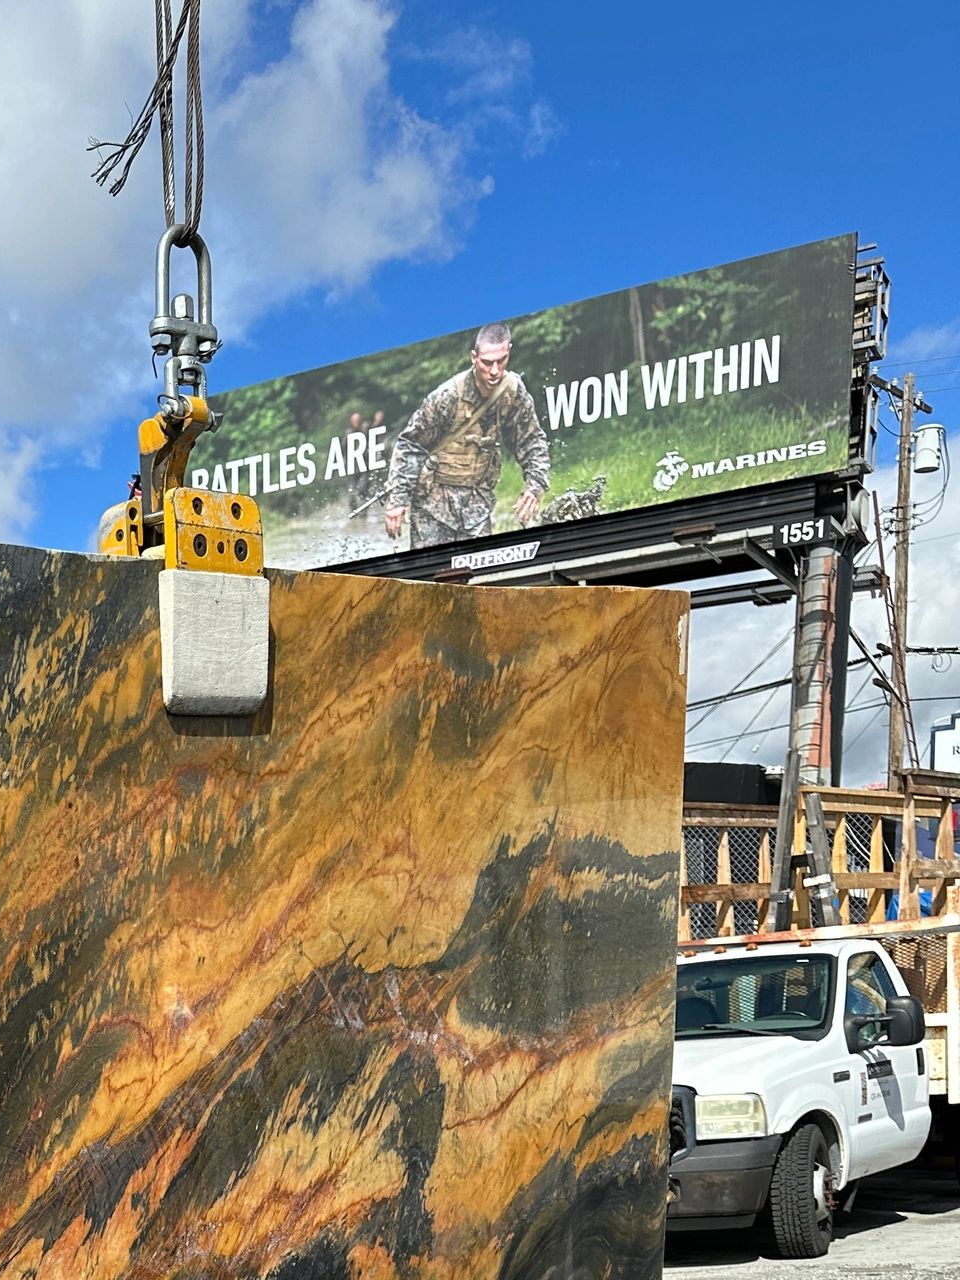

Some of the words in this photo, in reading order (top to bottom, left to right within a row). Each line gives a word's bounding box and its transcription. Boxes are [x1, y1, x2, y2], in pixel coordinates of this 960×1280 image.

[324, 426, 387, 480] ARE
[545, 369, 628, 430] WON
[641, 335, 780, 410] WITHIN
[692, 440, 827, 478] MARINES
[780, 519, 824, 544] 1551
[453, 544, 536, 569] OUTFRONT
